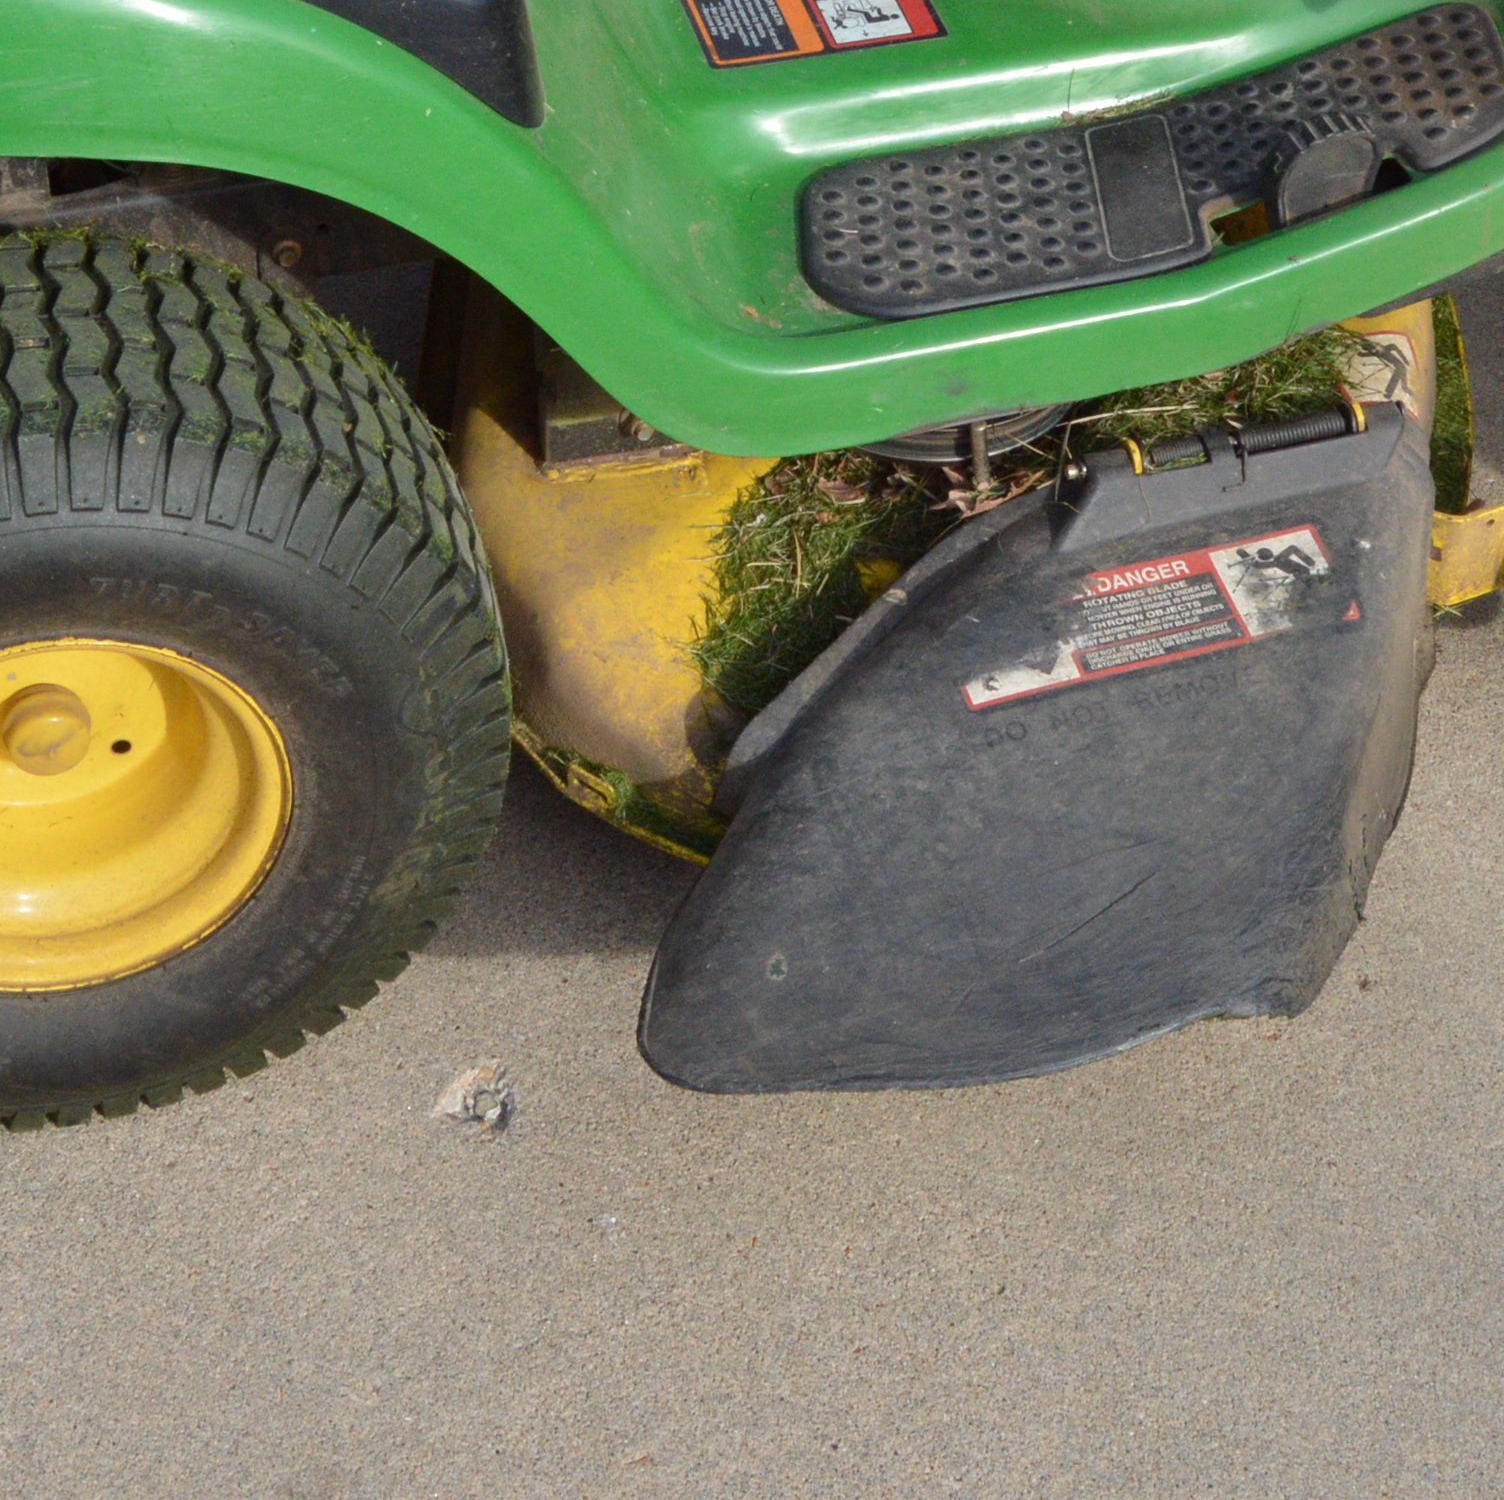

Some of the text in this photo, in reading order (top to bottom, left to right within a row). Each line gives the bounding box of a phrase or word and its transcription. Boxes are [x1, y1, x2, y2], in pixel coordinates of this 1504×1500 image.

[1095, 559, 1190, 592] DANGER
[1082, 579, 1187, 609] ROTATING BLADE
[1119, 605, 1142, 615] WHEN
[1143, 598, 1171, 610] ENGINE
[1181, 588, 1217, 601] RUNNING
[1153, 591, 1173, 601] FEET
[1173, 585, 1200, 596] UNDER
[1200, 582, 1214, 590] OR
[1091, 613, 1143, 630] THROWN
[1145, 600, 1201, 618] OBJECTS
[1136, 617, 1161, 628] CLEAR
[1191, 603, 1224, 616] OBJECTS
[1100, 647, 1117, 657] NOT
[1119, 638, 1157, 652] OPERATE
[1159, 630, 1191, 642] MOWER
[1191, 621, 1228, 635] WITHOUT
[1129, 624, 1162, 637] THROWN
[1088, 649, 1134, 665] DISCHARGE
[1135, 642, 1162, 654] CHUTE
[1175, 633, 1204, 645] ENTIRE
[1204, 626, 1232, 638] GRASS
[1090, 657, 1128, 670] CATCHER
[1139, 648, 1165, 659] PLACE
